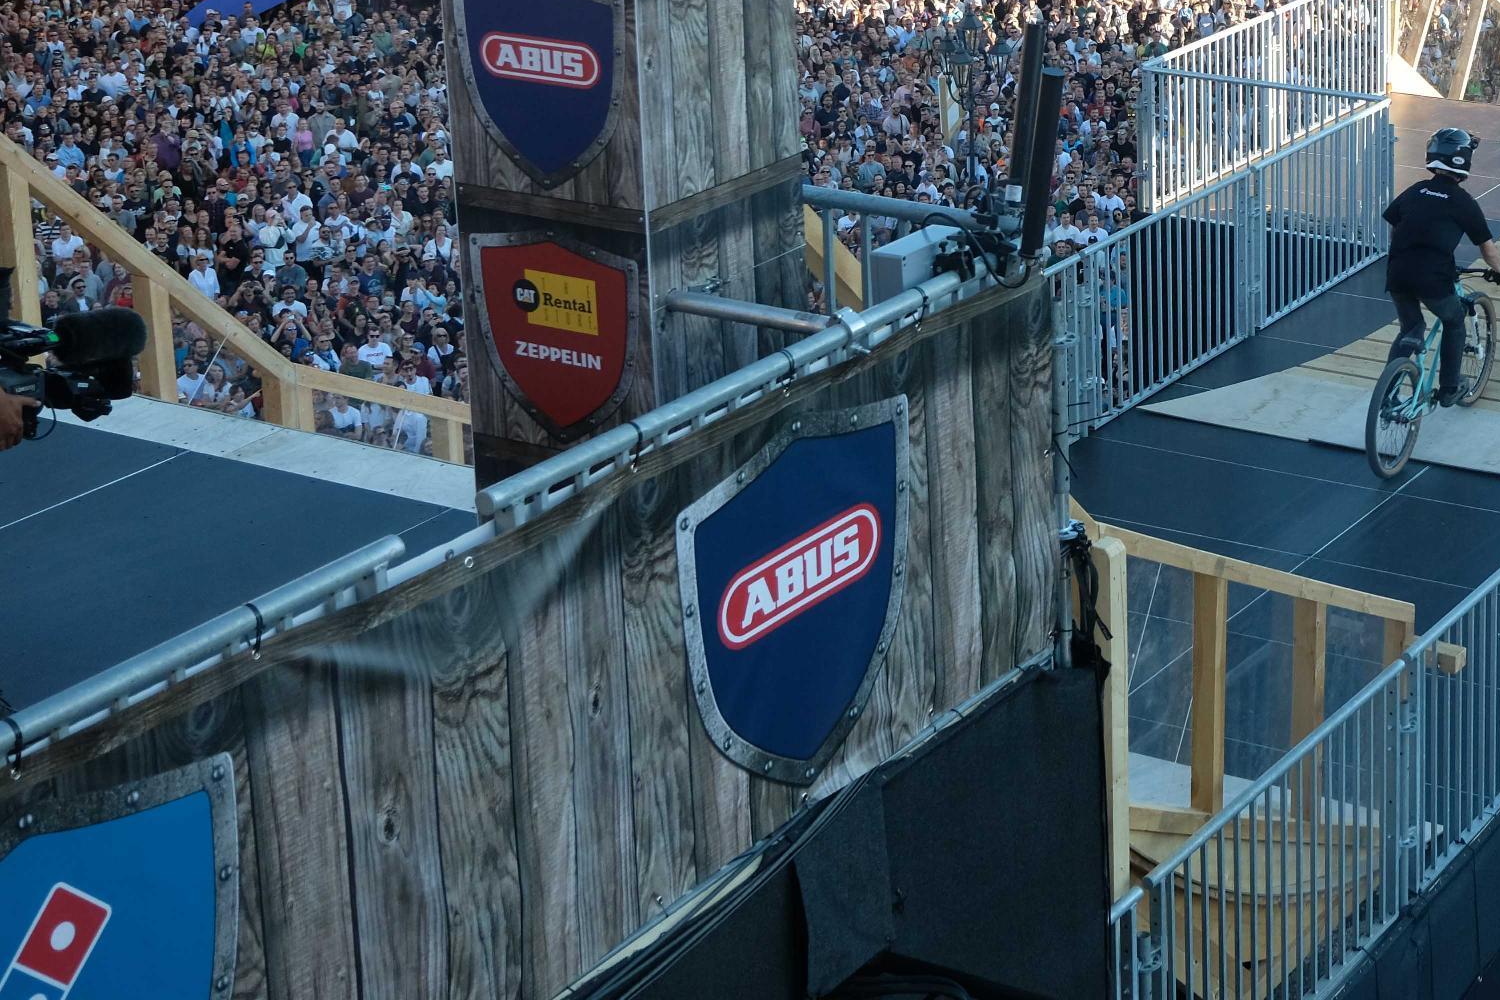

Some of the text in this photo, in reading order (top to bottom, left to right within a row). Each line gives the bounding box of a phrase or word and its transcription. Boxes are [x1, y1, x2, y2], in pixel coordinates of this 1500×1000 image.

[496, 43, 584, 78] ABUS
[516, 287, 592, 314] CAT Rental
[515, 340, 602, 371] ZEPPELIN
[741, 523, 860, 629] ABUS
